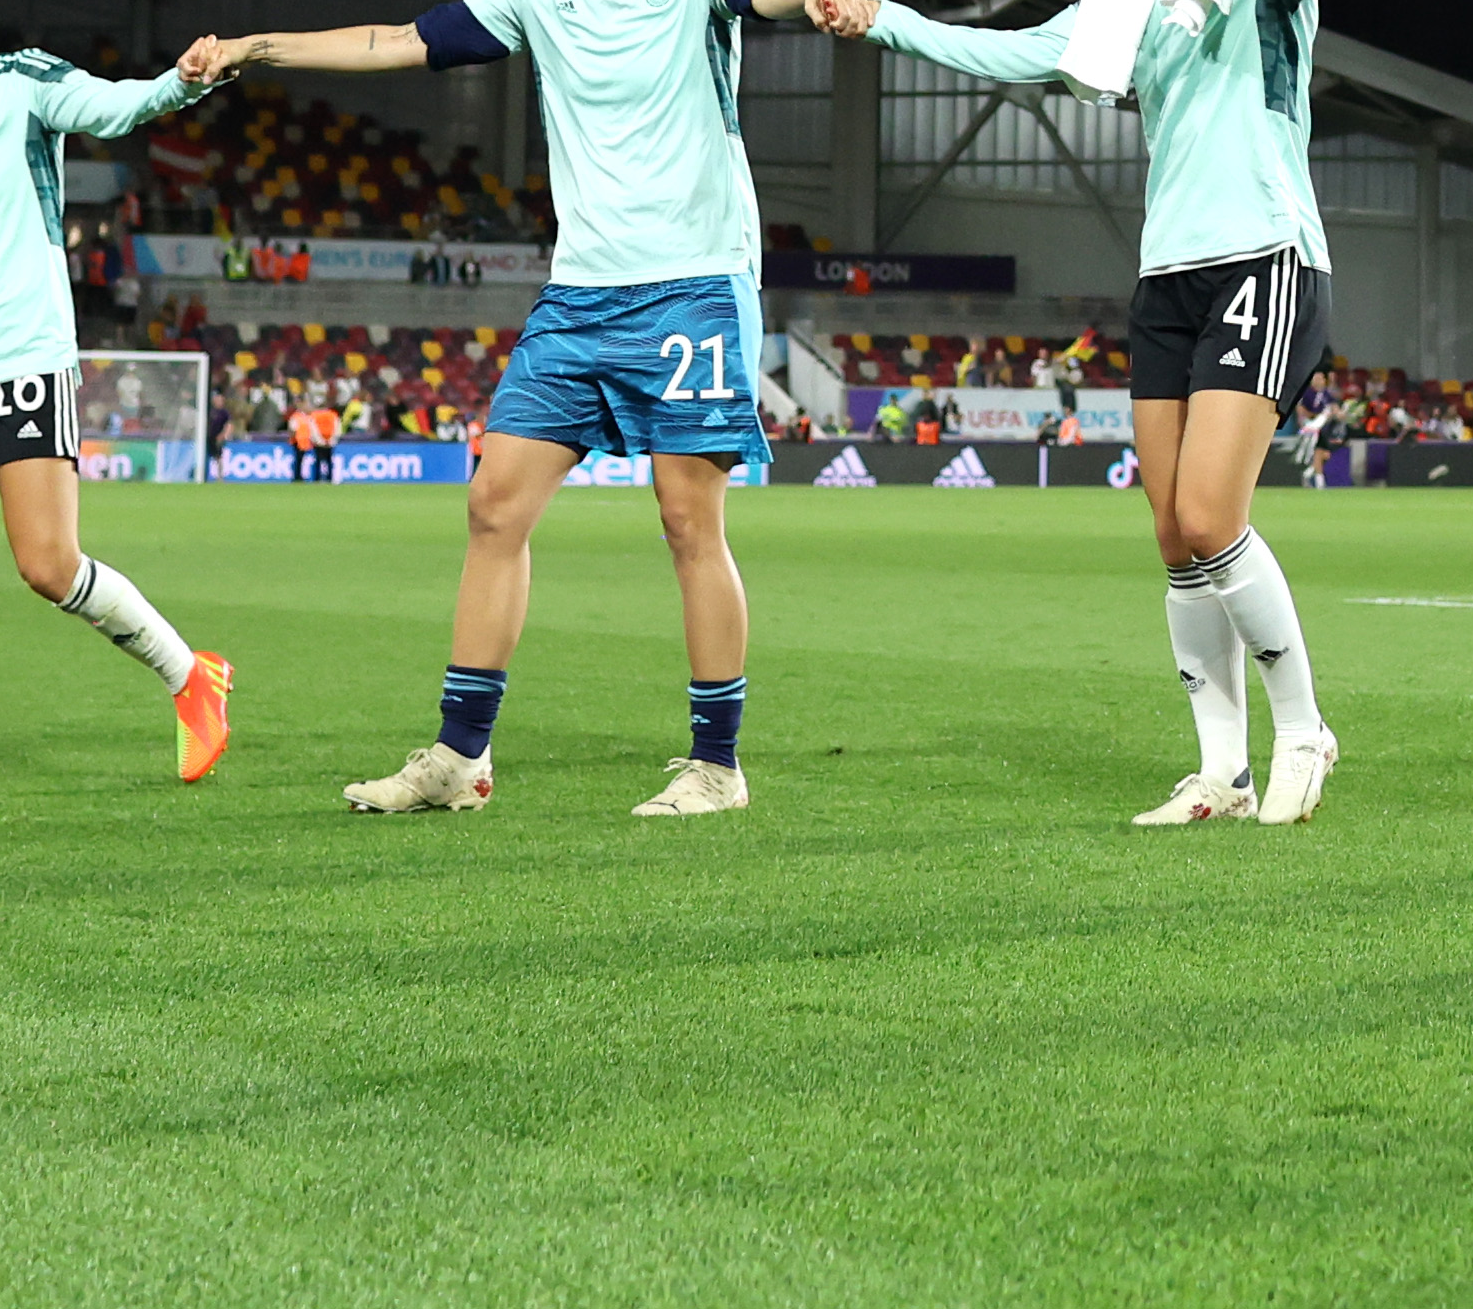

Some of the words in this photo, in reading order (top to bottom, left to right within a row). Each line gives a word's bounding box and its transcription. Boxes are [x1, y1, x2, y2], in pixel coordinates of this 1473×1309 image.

[815, 260, 911, 282] LODON
[1222, 275, 1258, 341] 4
[659, 333, 735, 401] 21
